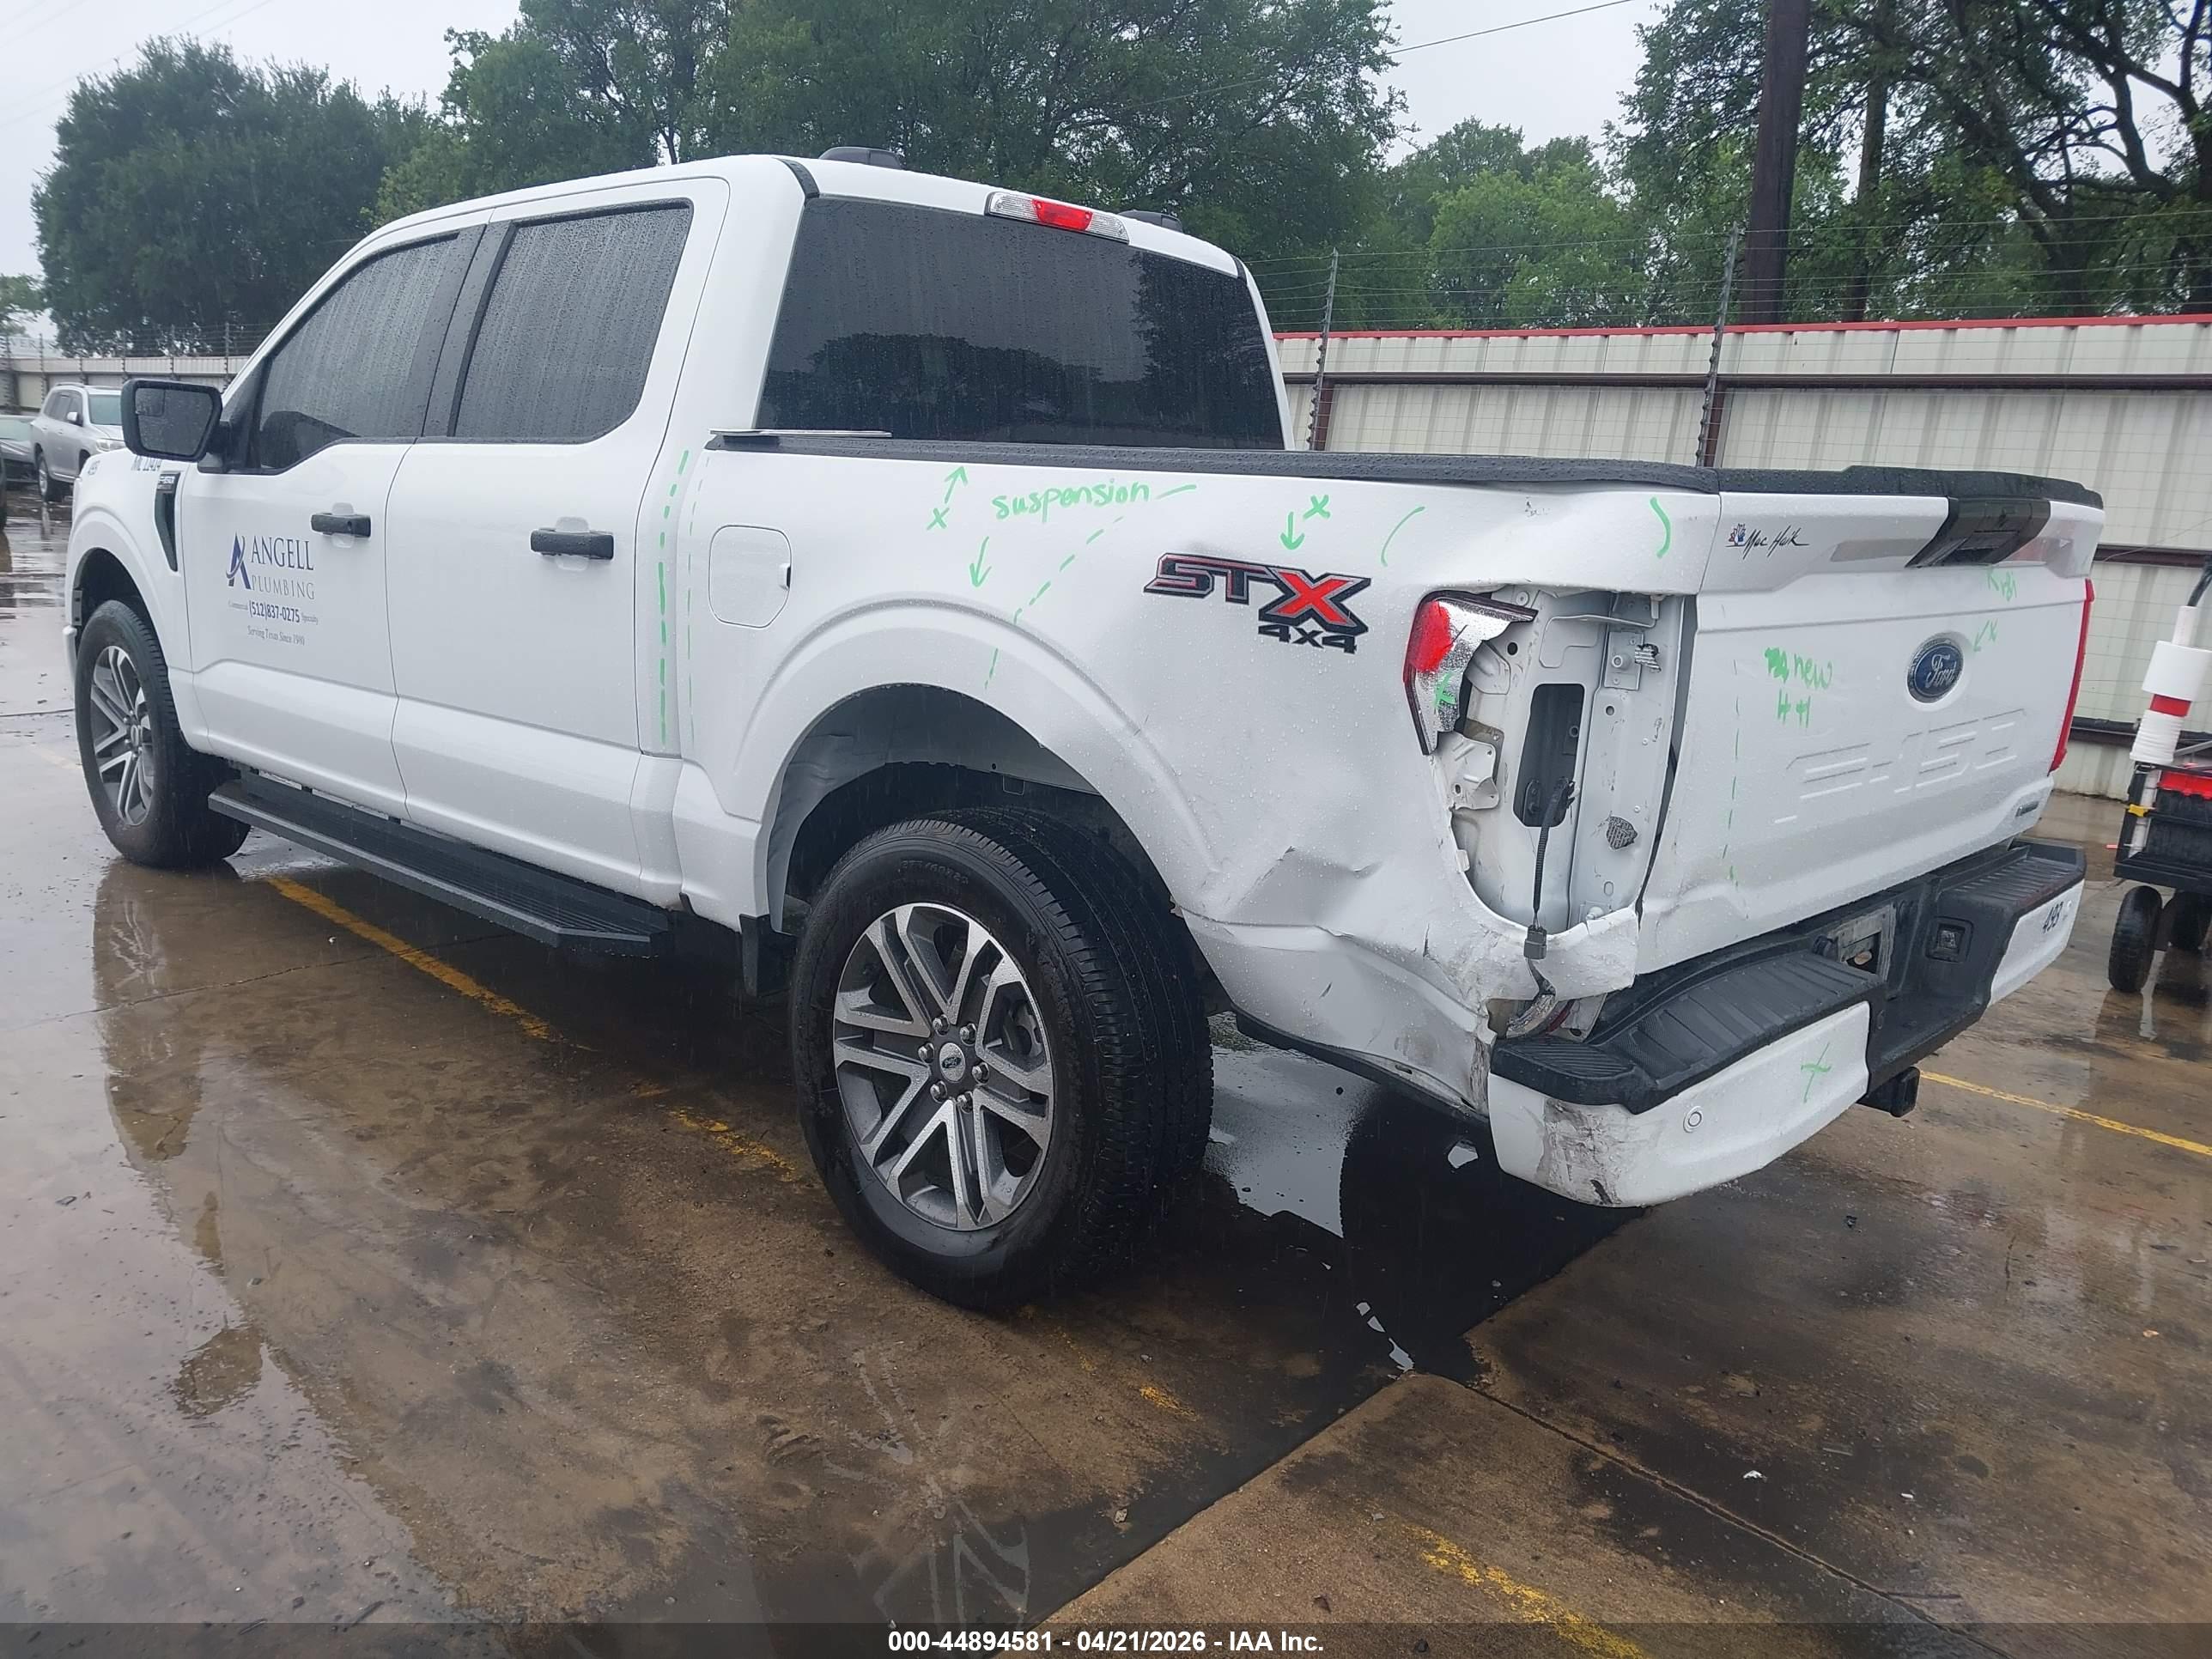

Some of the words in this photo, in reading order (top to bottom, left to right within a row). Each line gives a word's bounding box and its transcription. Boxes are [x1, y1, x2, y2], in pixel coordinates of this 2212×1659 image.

[992, 477, 1150, 523] suspension
[251, 536, 314, 571] ANGELL
[1742, 529, 1768, 560] Mac
[252, 574, 315, 600] PLUMBING
[1144, 552, 1372, 636] STX
[248, 600, 301, 623] (512)837-0275
[1793, 653, 1833, 690] new
[1924, 653, 1957, 688] Ford
